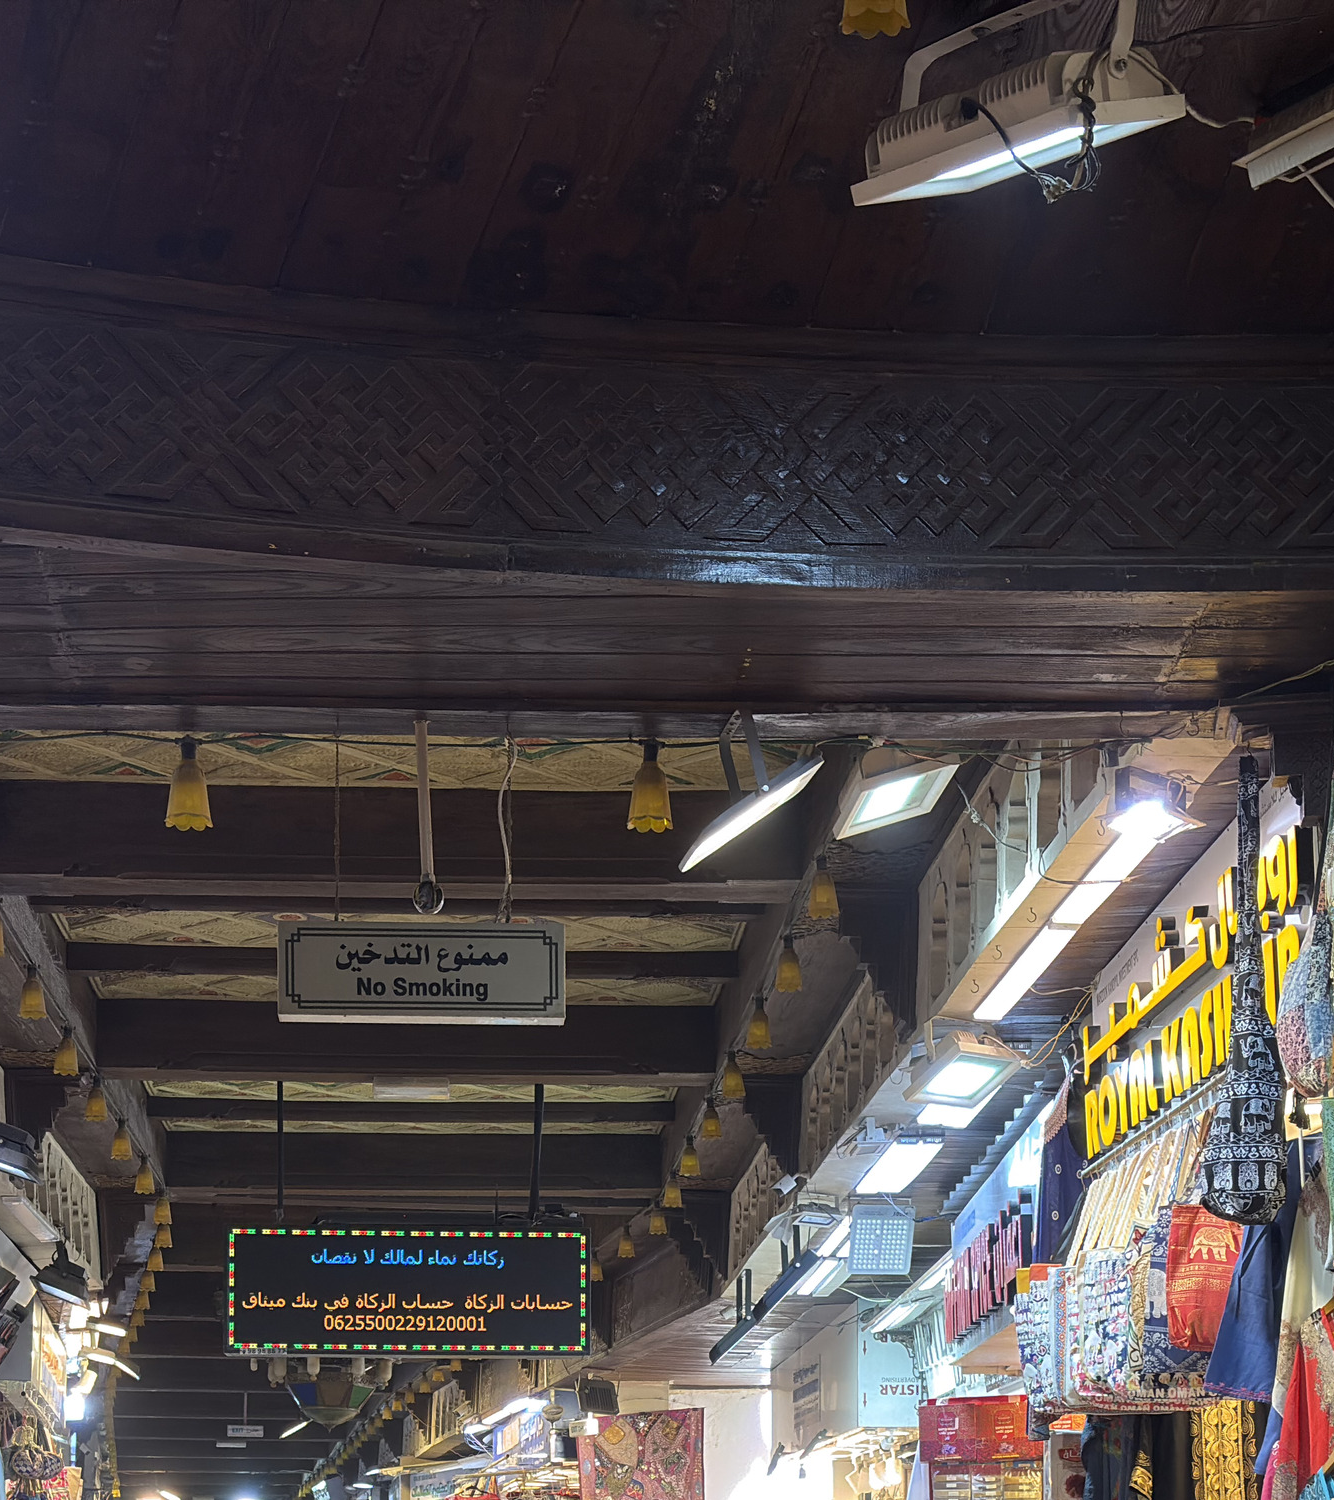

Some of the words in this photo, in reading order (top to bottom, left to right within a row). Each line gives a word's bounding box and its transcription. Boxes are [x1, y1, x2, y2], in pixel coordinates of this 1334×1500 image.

[335, 941, 430, 973] التدخين
[436, 942, 509, 973] ممنوع
[356, 977, 386, 997] No
[393, 977, 489, 1001] Smoking
[1083, 912, 1208, 1087] كشمير
[1083, 1039, 1159, 1160] ROYAL
[1160, 923, 1301, 1104] KASHIR
[311, 1249, 357, 1266] نقصان
[363, 1249, 376, 1266] لا
[380, 1249, 424, 1267] لمالك
[428, 1250, 458, 1267] نماء
[462, 1250, 506, 1269] زكاتك
[241, 1292, 287, 1310] ميثاق
[291, 1293, 319, 1309] بنك
[324, 1296, 350, 1311] في
[355, 1293, 397, 1311] الزكاة
[401, 1293, 454, 1311] حساب
[464, 1294, 505, 1311] الزكاة
[510, 1294, 574, 1311] حسابات
[323, 1315, 487, 1333] 0625500229120001
